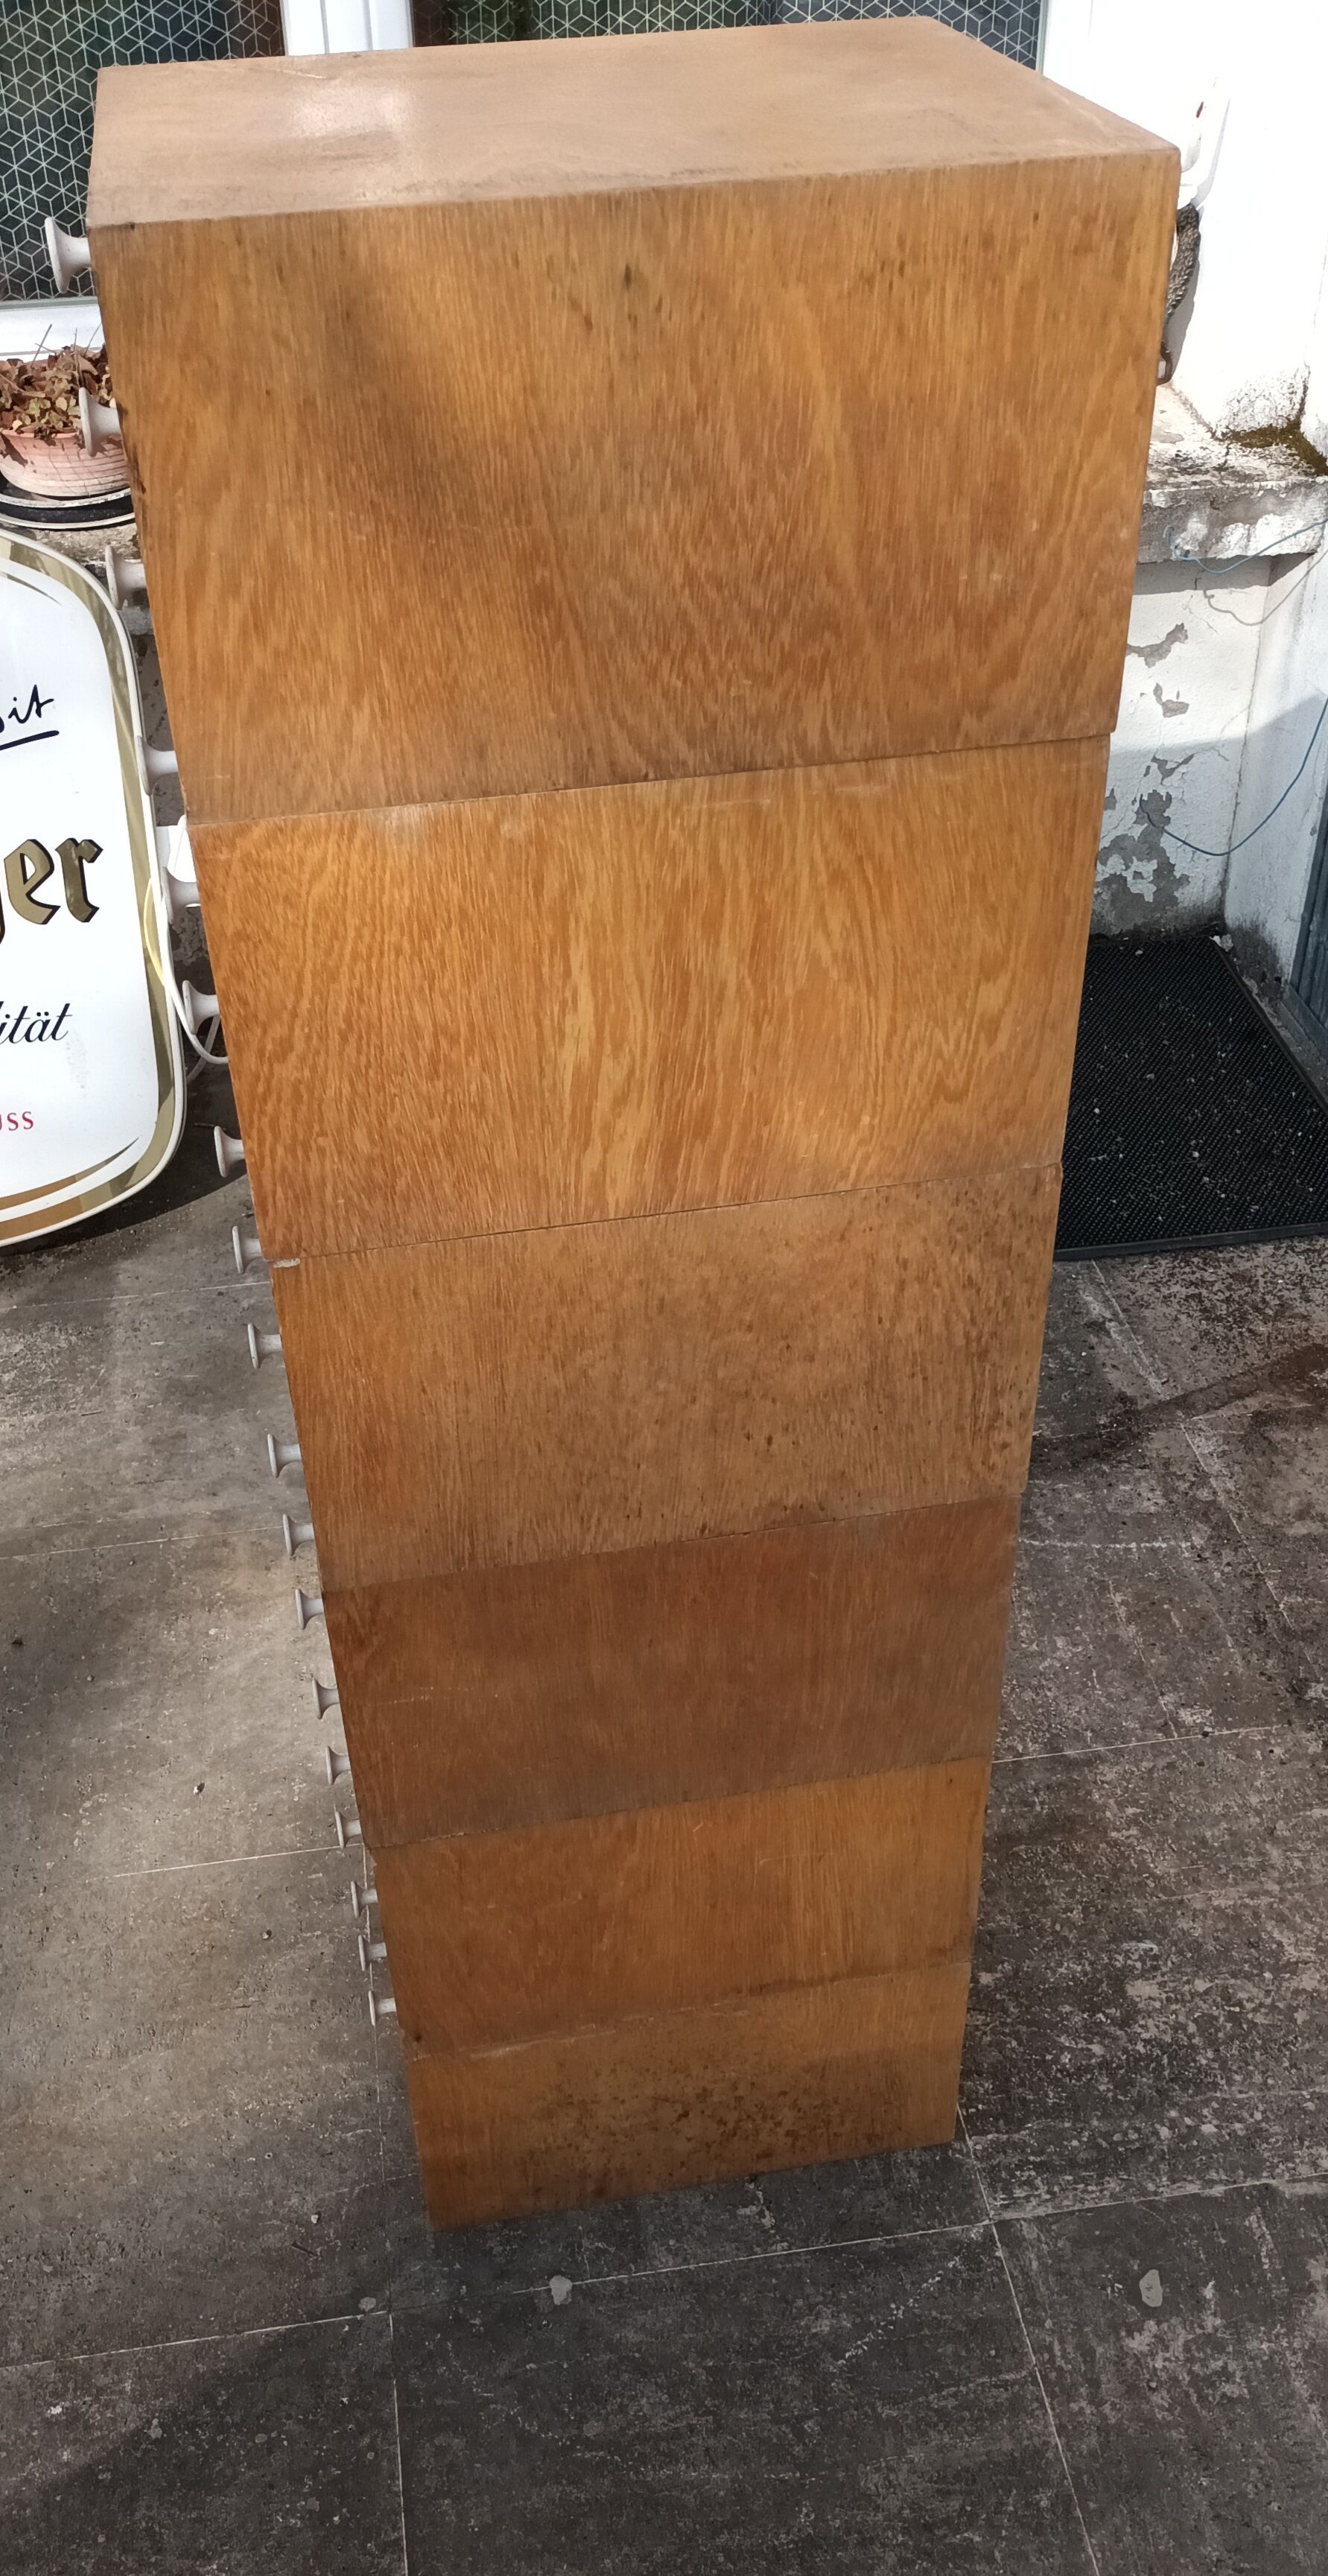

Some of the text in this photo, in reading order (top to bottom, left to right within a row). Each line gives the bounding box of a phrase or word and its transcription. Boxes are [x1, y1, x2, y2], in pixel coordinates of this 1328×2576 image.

[0, 684, 54, 734] it
[0, 837, 104, 943] er
[0, 1000, 73, 1044] ität
[0, 1111, 34, 1132] SS
